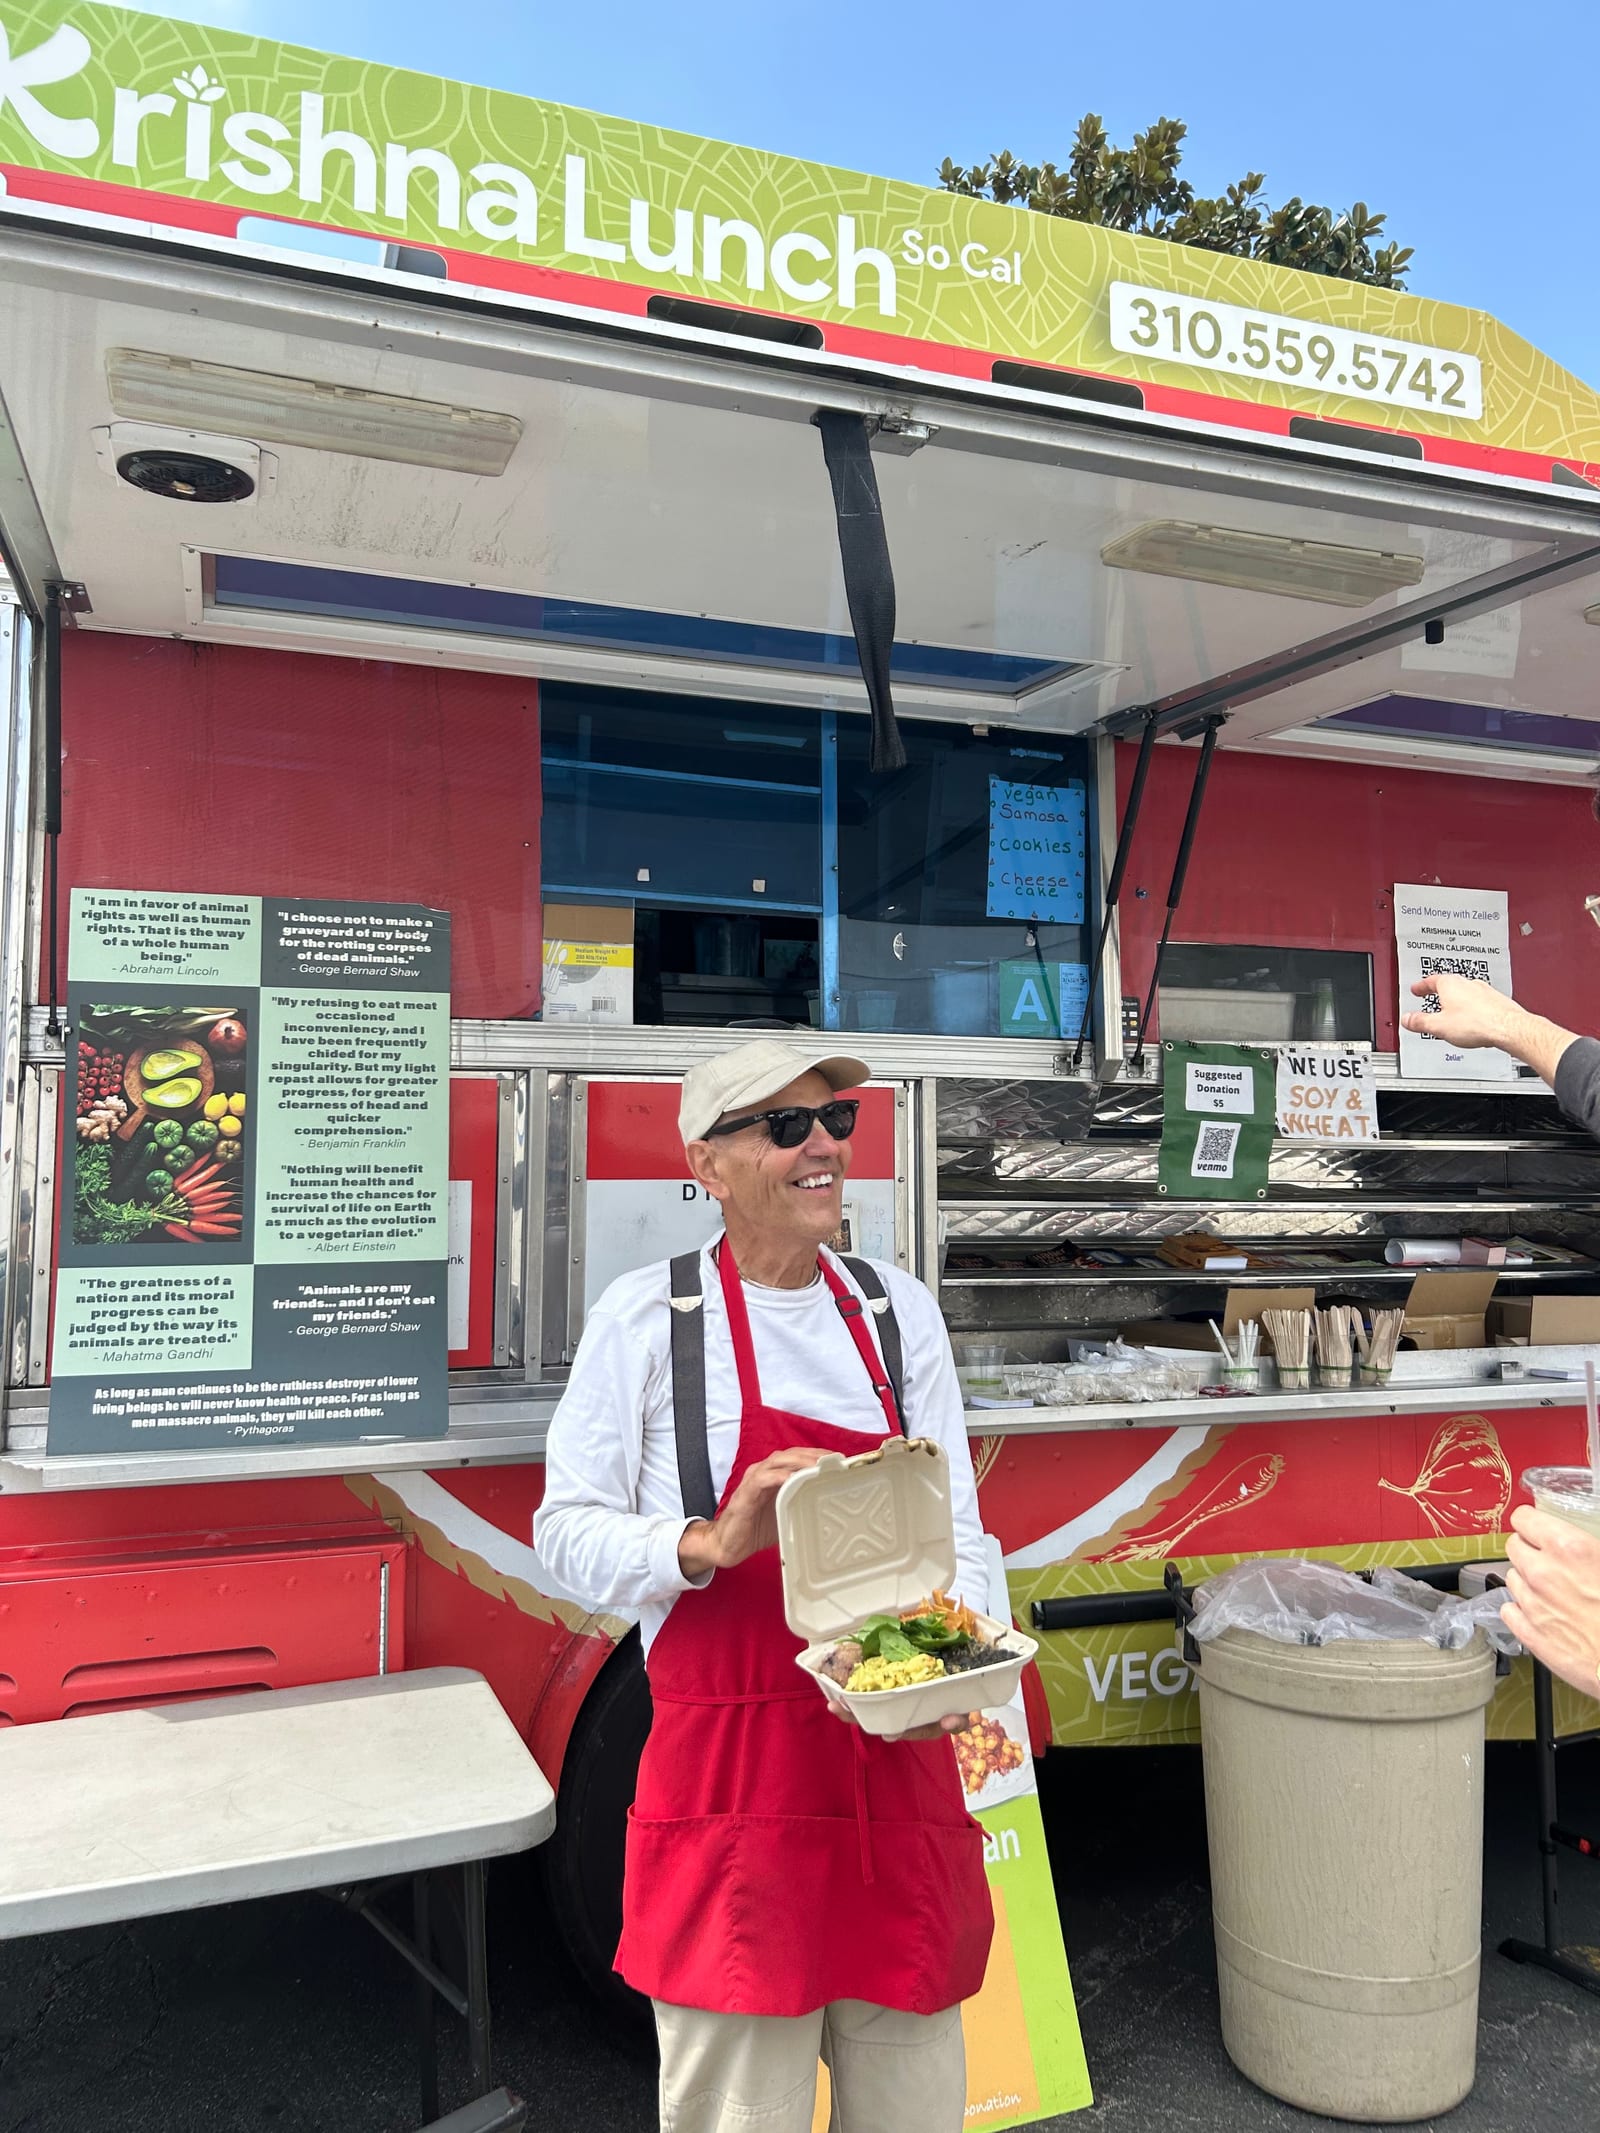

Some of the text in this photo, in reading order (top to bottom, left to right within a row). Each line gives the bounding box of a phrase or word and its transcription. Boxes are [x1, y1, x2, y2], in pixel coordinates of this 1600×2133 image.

[0, 18, 897, 318] Krishna Lunch
[902, 229, 1021, 285] So Cal
[1128, 297, 1466, 410] 310.559.5742
[1000, 803, 1069, 823] Samosa
[1000, 838, 1071, 853] Cookies
[1001, 872, 1069, 887] Cheese
[124, 898, 137, 907] in
[140, 898, 179, 909] favor
[182, 901, 196, 910] of
[199, 902, 248, 912] animal
[1401, 904, 1422, 915] Send
[1423, 906, 1451, 919] Money
[1452, 909, 1470, 918] with
[81, 909, 125, 921] rights
[148, 913, 179, 922] well
[181, 915, 198, 923] as
[201, 914, 250, 925] human
[291, 912, 341, 923] choose
[343, 916, 366, 924] not
[368, 916, 383, 924] to
[385, 917, 422, 926] make
[86, 923, 245, 940] rights. That is the way
[282, 926, 428, 941] graveyard of my body
[1458, 929, 1481, 937] LUNCH
[102, 936, 117, 945] of
[131, 938, 176, 948] whole
[179, 939, 229, 950] human
[279, 937, 431, 953] for the rotting corpses
[1406, 940, 1444, 950] SOUTHERN
[1445, 944, 1486, 953] CALIFORNIA
[297, 951, 311, 960] of
[313, 951, 348, 961] dead
[119, 963, 218, 976] Abraham Lincoln
[299, 963, 419, 976] George Bernard Shaw
[300, 997, 359, 1009] refusing
[361, 999, 376, 1008] to
[378, 1000, 400, 1008] eat
[403, 1002, 436, 1010] meat
[1011, 978, 1048, 1021] A
[1287, 1056, 1363, 1078] WE USE
[1194, 1069, 1242, 1081] Suggested
[1196, 1083, 1239, 1094] Donation
[1213, 1098, 1223, 1107] $5
[1289, 1085, 1362, 1110] SOY &
[1283, 1112, 1370, 1138] WHEAT
[345, 1164, 370, 1173] will
[373, 1164, 423, 1173] benefit
[1197, 1163, 1227, 1171] venmo
[290, 1176, 413, 1186] human health and
[266, 1189, 436, 1200] increase the chances for
[271, 1203, 328, 1213] survival
[331, 1203, 345, 1212] of
[348, 1203, 371, 1212] life
[394, 1202, 431, 1211] Earth
[284, 1216, 323, 1226] much
[345, 1216, 368, 1225] the
[371, 1215, 436, 1224] evolution
[279, 1231, 293, 1239] to
[307, 1228, 383, 1240] vegetarian
[313, 1241, 395, 1251] Albert Einstein
[119, 1278, 200, 1290] greatness
[203, 1275, 219, 1285] of
[363, 1285, 387, 1293] are
[389, 1284, 411, 1294] my
[75, 1289, 234, 1303] nation and its moral
[338, 1296, 365, 1306] and
[367, 1297, 372, 1306] I
[375, 1295, 410, 1305] don't
[412, 1295, 435, 1304] eat
[90, 1305, 218, 1320] progress can be
[313, 1312, 334, 1323] my
[68, 1319, 237, 1335] judged by the way its
[296, 1321, 420, 1336] George Bernard Shaw
[68, 1336, 134, 1348] animals
[137, 1337, 164, 1345] are
[102, 1347, 213, 1361] Mahatma Gandhi
[234, 1425, 294, 1437] Pythagoras
